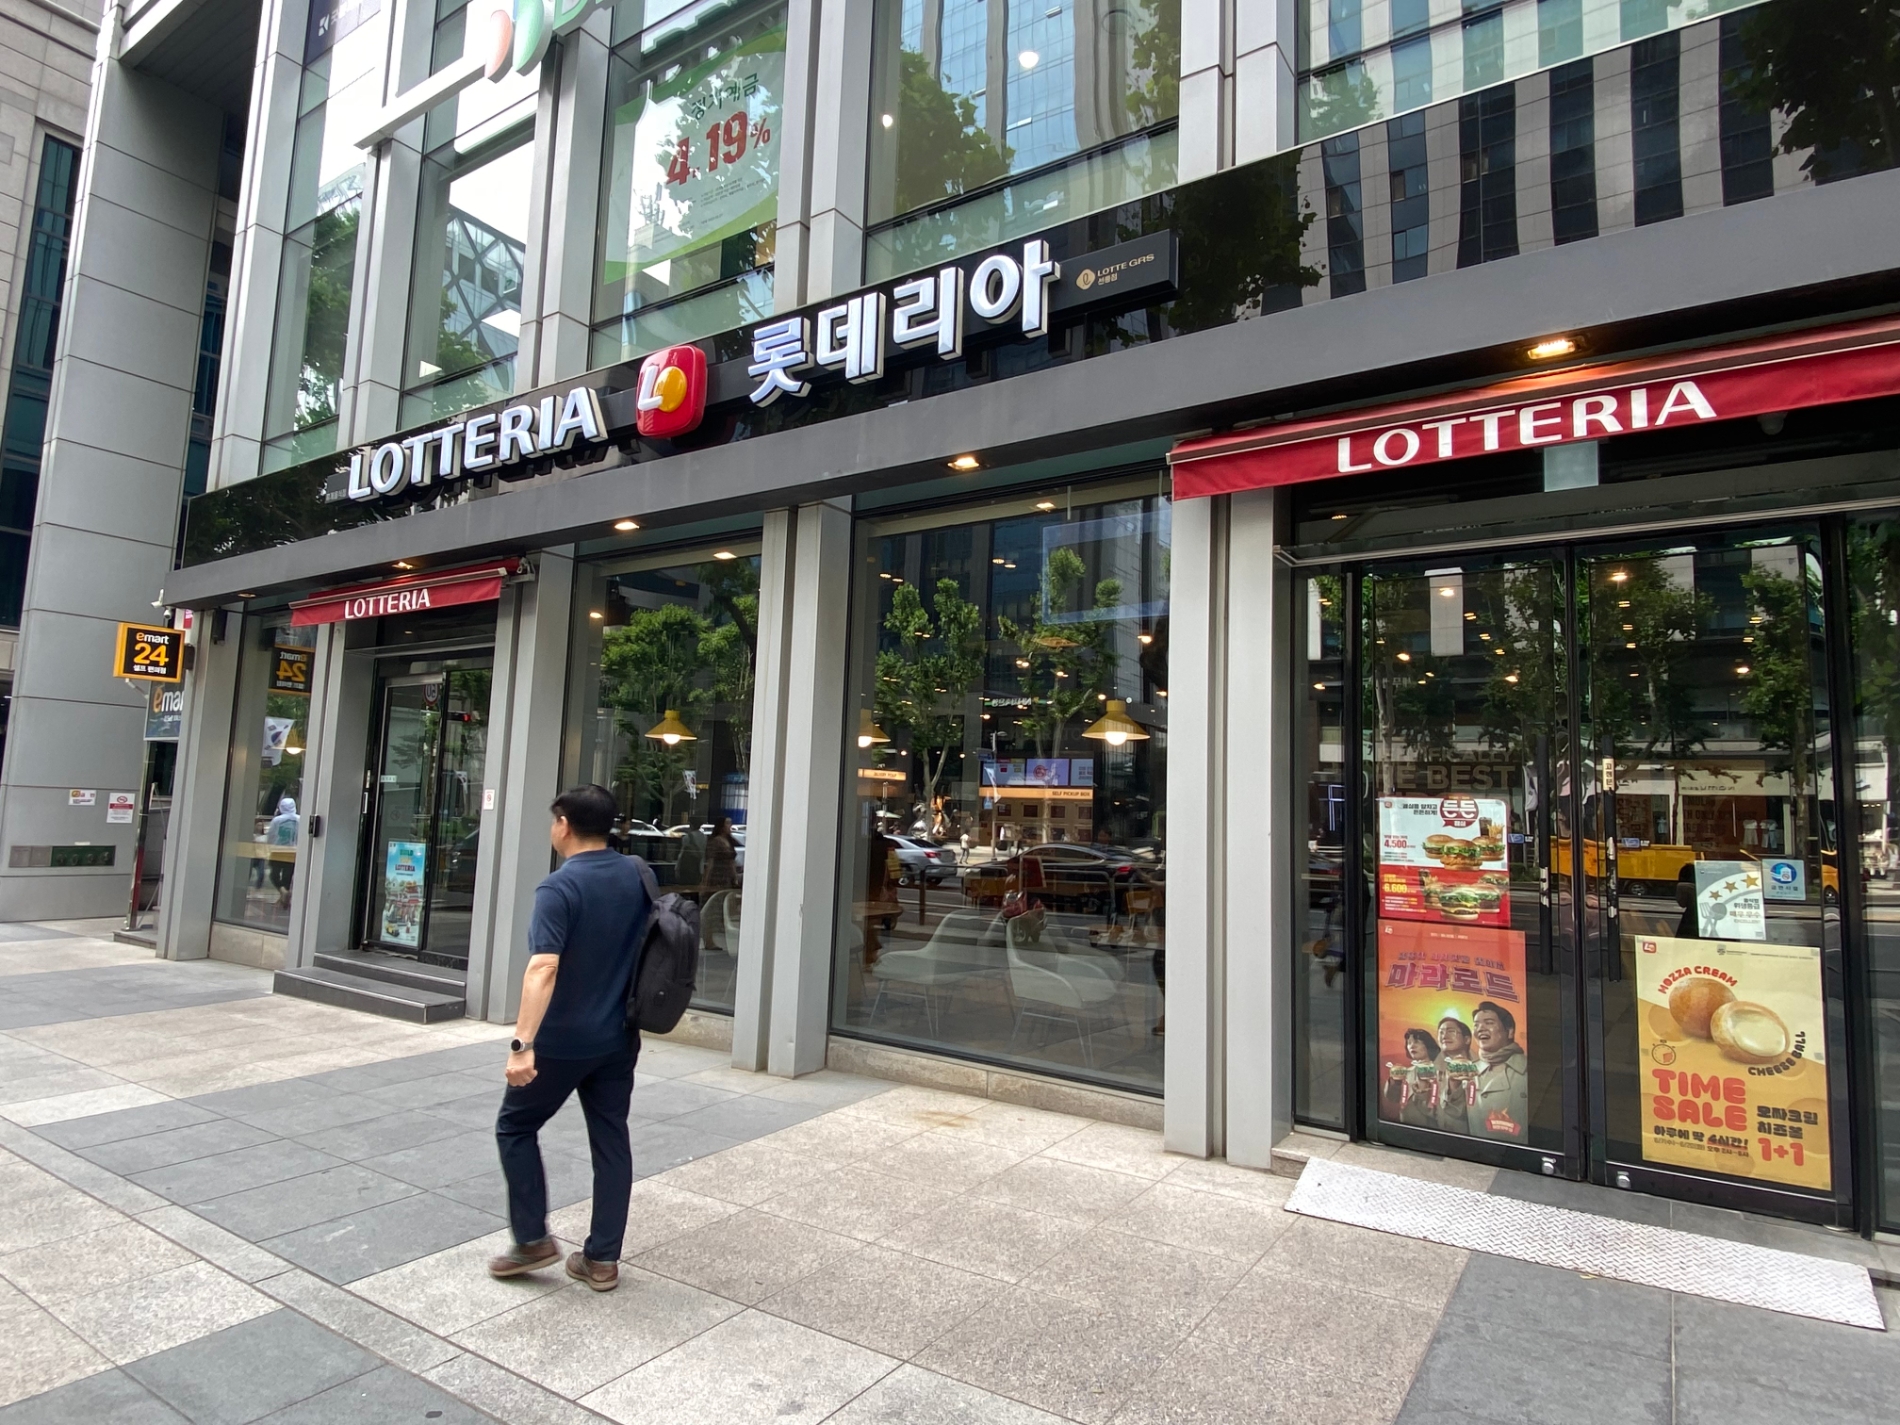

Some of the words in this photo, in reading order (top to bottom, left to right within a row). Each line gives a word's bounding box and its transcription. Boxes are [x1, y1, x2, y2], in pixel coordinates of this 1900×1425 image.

[1097, 261, 1128, 277] LOTTE
[1129, 253, 1155, 267] GRS
[748, 239, 1060, 407] 롯데리아
[1337, 380, 1717, 474] LOTTERIA
[349, 386, 606, 501] LOTTERIA
[344, 588, 431, 619] LOTTERIA
[136, 631, 170, 645] emart
[133, 642, 170, 667] 24
[1427, 765, 1516, 790] BEST
[1442, 800, 1477, 818] 든든
[1385, 962, 1520, 1003] 마라로드
[1658, 966, 1693, 994] MOZZA
[1694, 965, 1738, 987] CREAM
[1748, 1057, 1796, 1077] CHEESE
[1791, 1031, 1806, 1060] BALL
[1652, 1068, 1746, 1104] TIME
[1652, 1095, 1747, 1131] SALE
[1757, 1106, 1818, 1125] 모짜크림
[1654, 1125, 1690, 1140] 하루에
[1692, 1130, 1704, 1142] 딱
[1707, 1134, 1749, 1148] 4시간!
[1757, 1121, 1803, 1139] 치즈볼
[1706, 1145, 1720, 1153] 오후
[1757, 1137, 1804, 1166] 1+1
